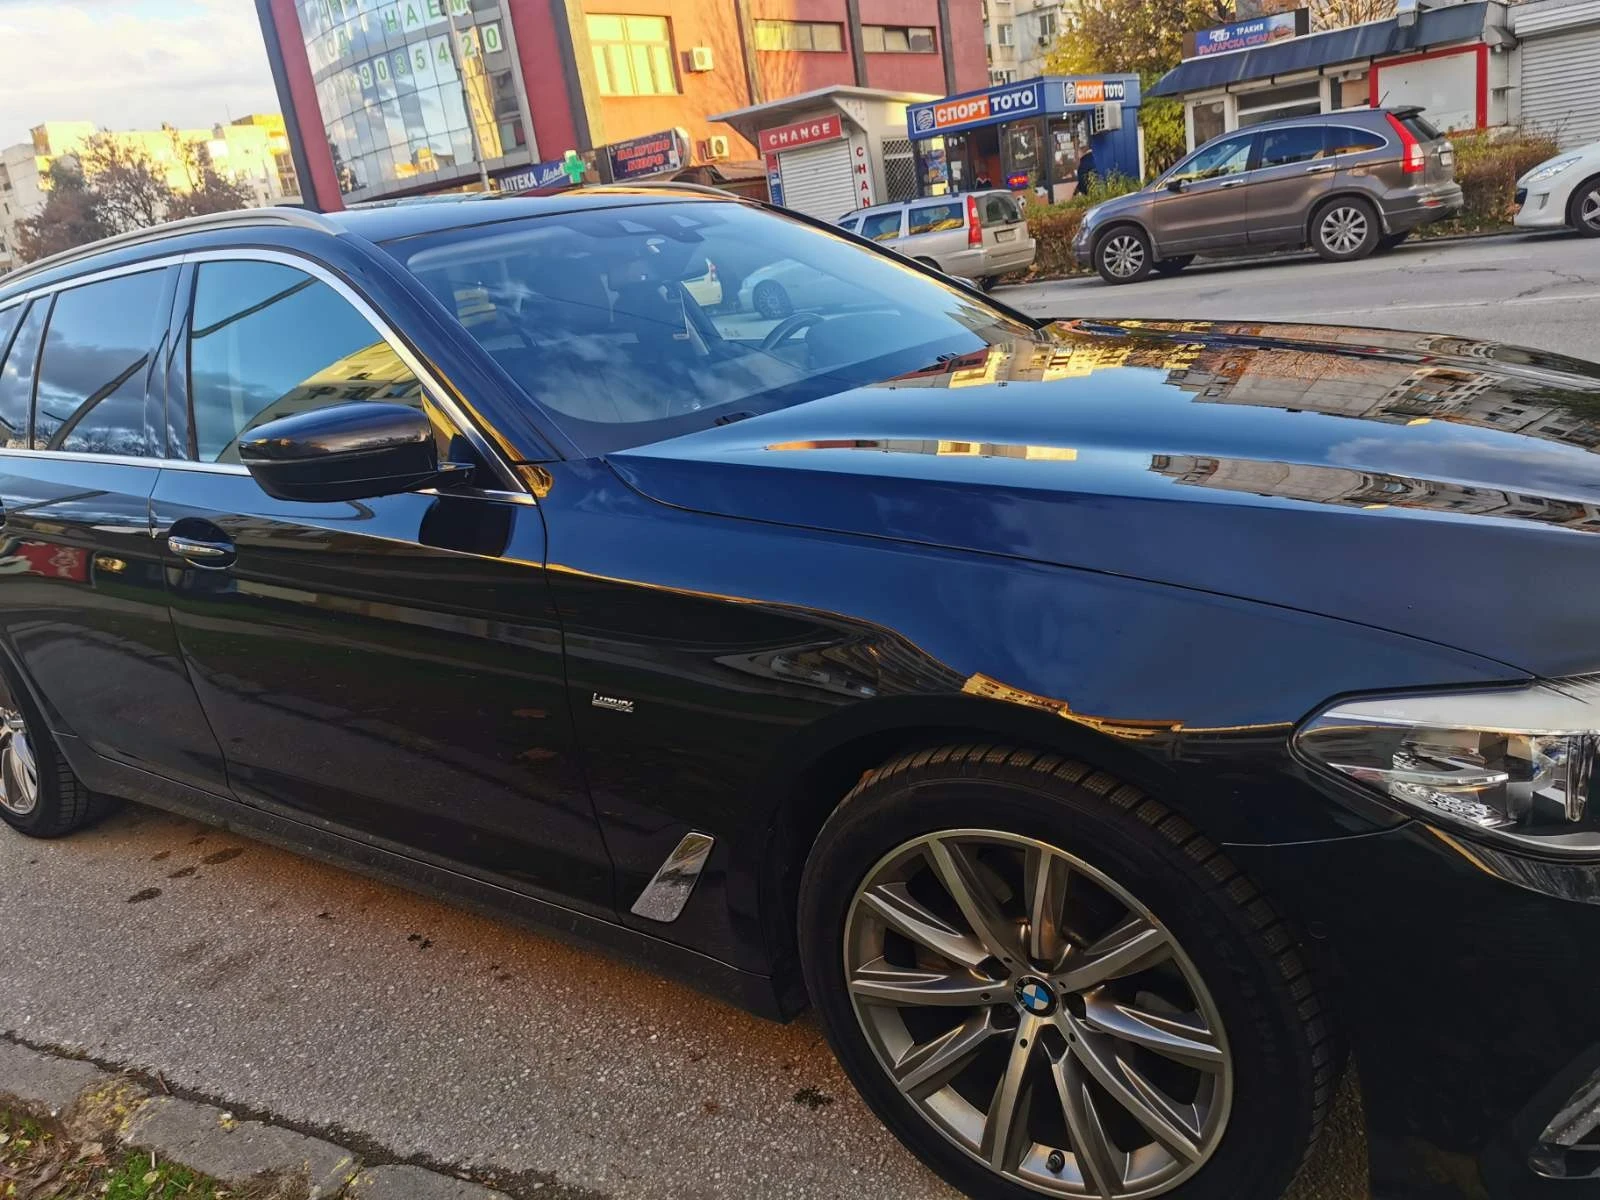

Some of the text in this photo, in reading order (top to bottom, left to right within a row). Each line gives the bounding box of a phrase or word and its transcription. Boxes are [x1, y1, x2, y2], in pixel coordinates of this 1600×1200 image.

[1236, 23, 1264, 36] ТРАКИЯ
[1077, 83, 1123, 98] СПОРТ ТОТО
[937, 90, 1033, 123] СПОРТ ТОТО
[769, 122, 831, 145] CHANGE
[499, 172, 538, 192] АПТЕКА
